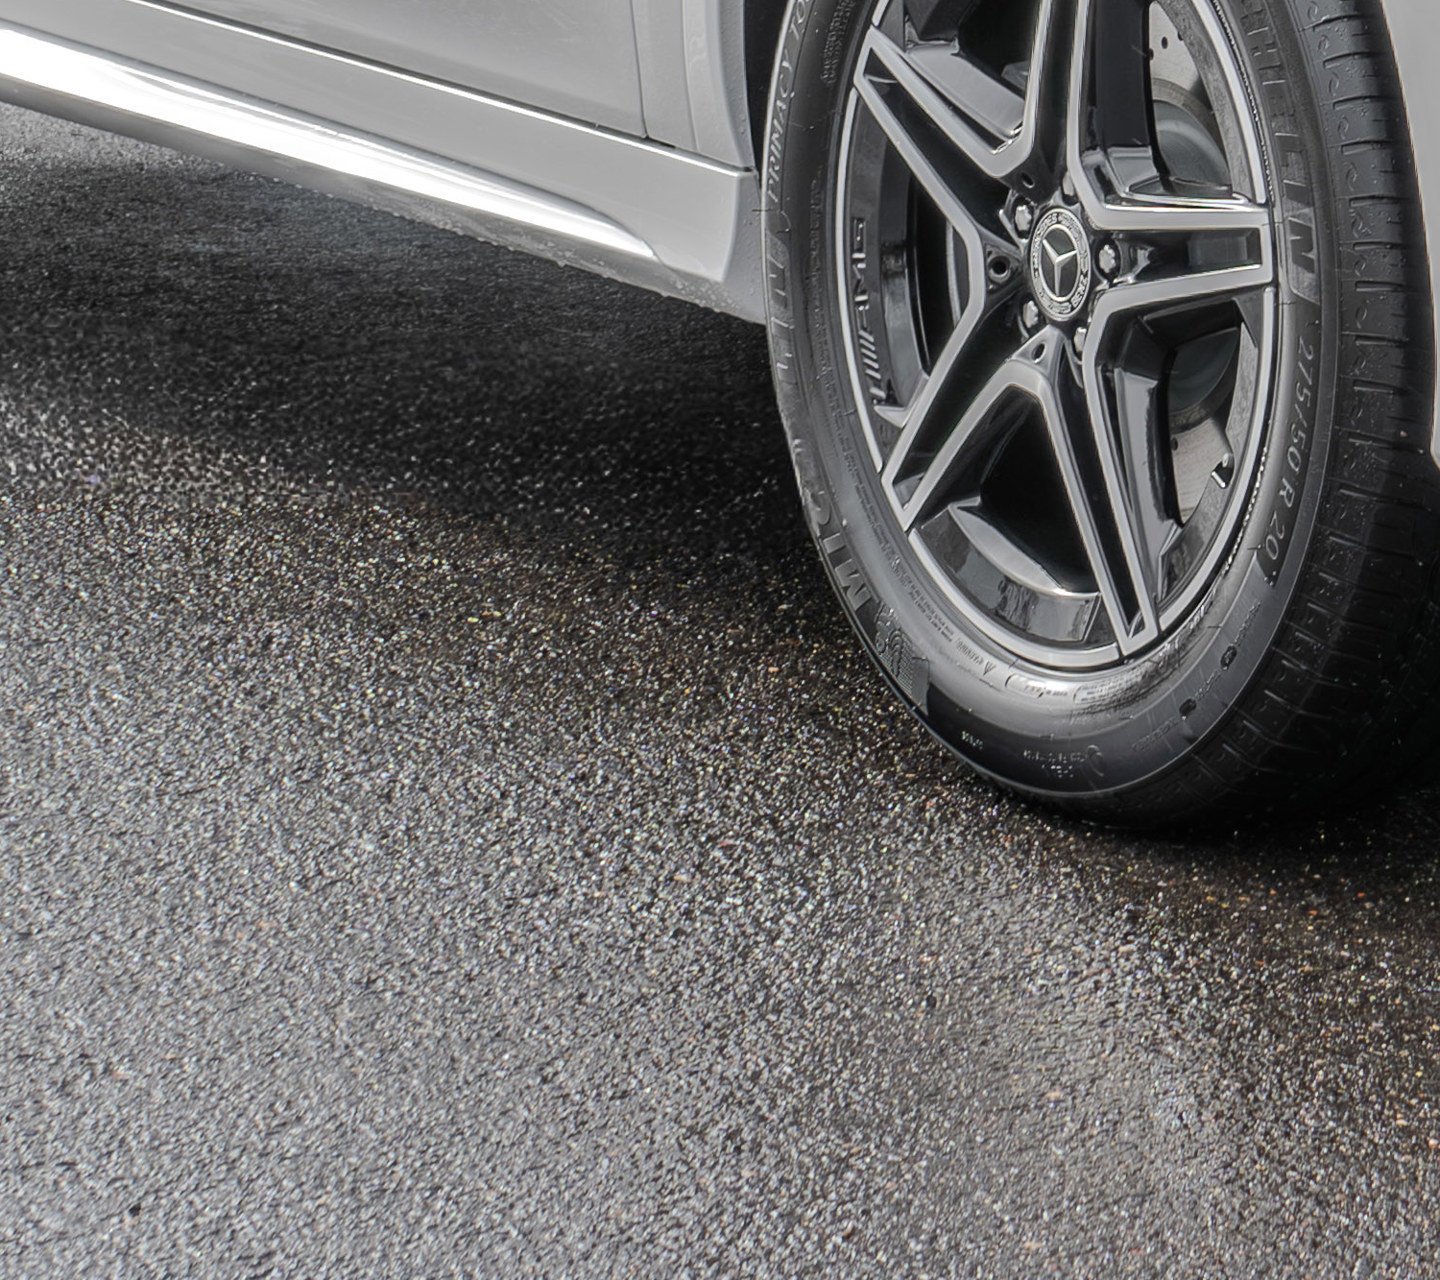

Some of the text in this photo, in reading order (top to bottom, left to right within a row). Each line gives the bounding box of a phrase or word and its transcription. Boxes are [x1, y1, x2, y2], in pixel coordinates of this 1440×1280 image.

[1265, 335, 1314, 561] 275/50 R 20
